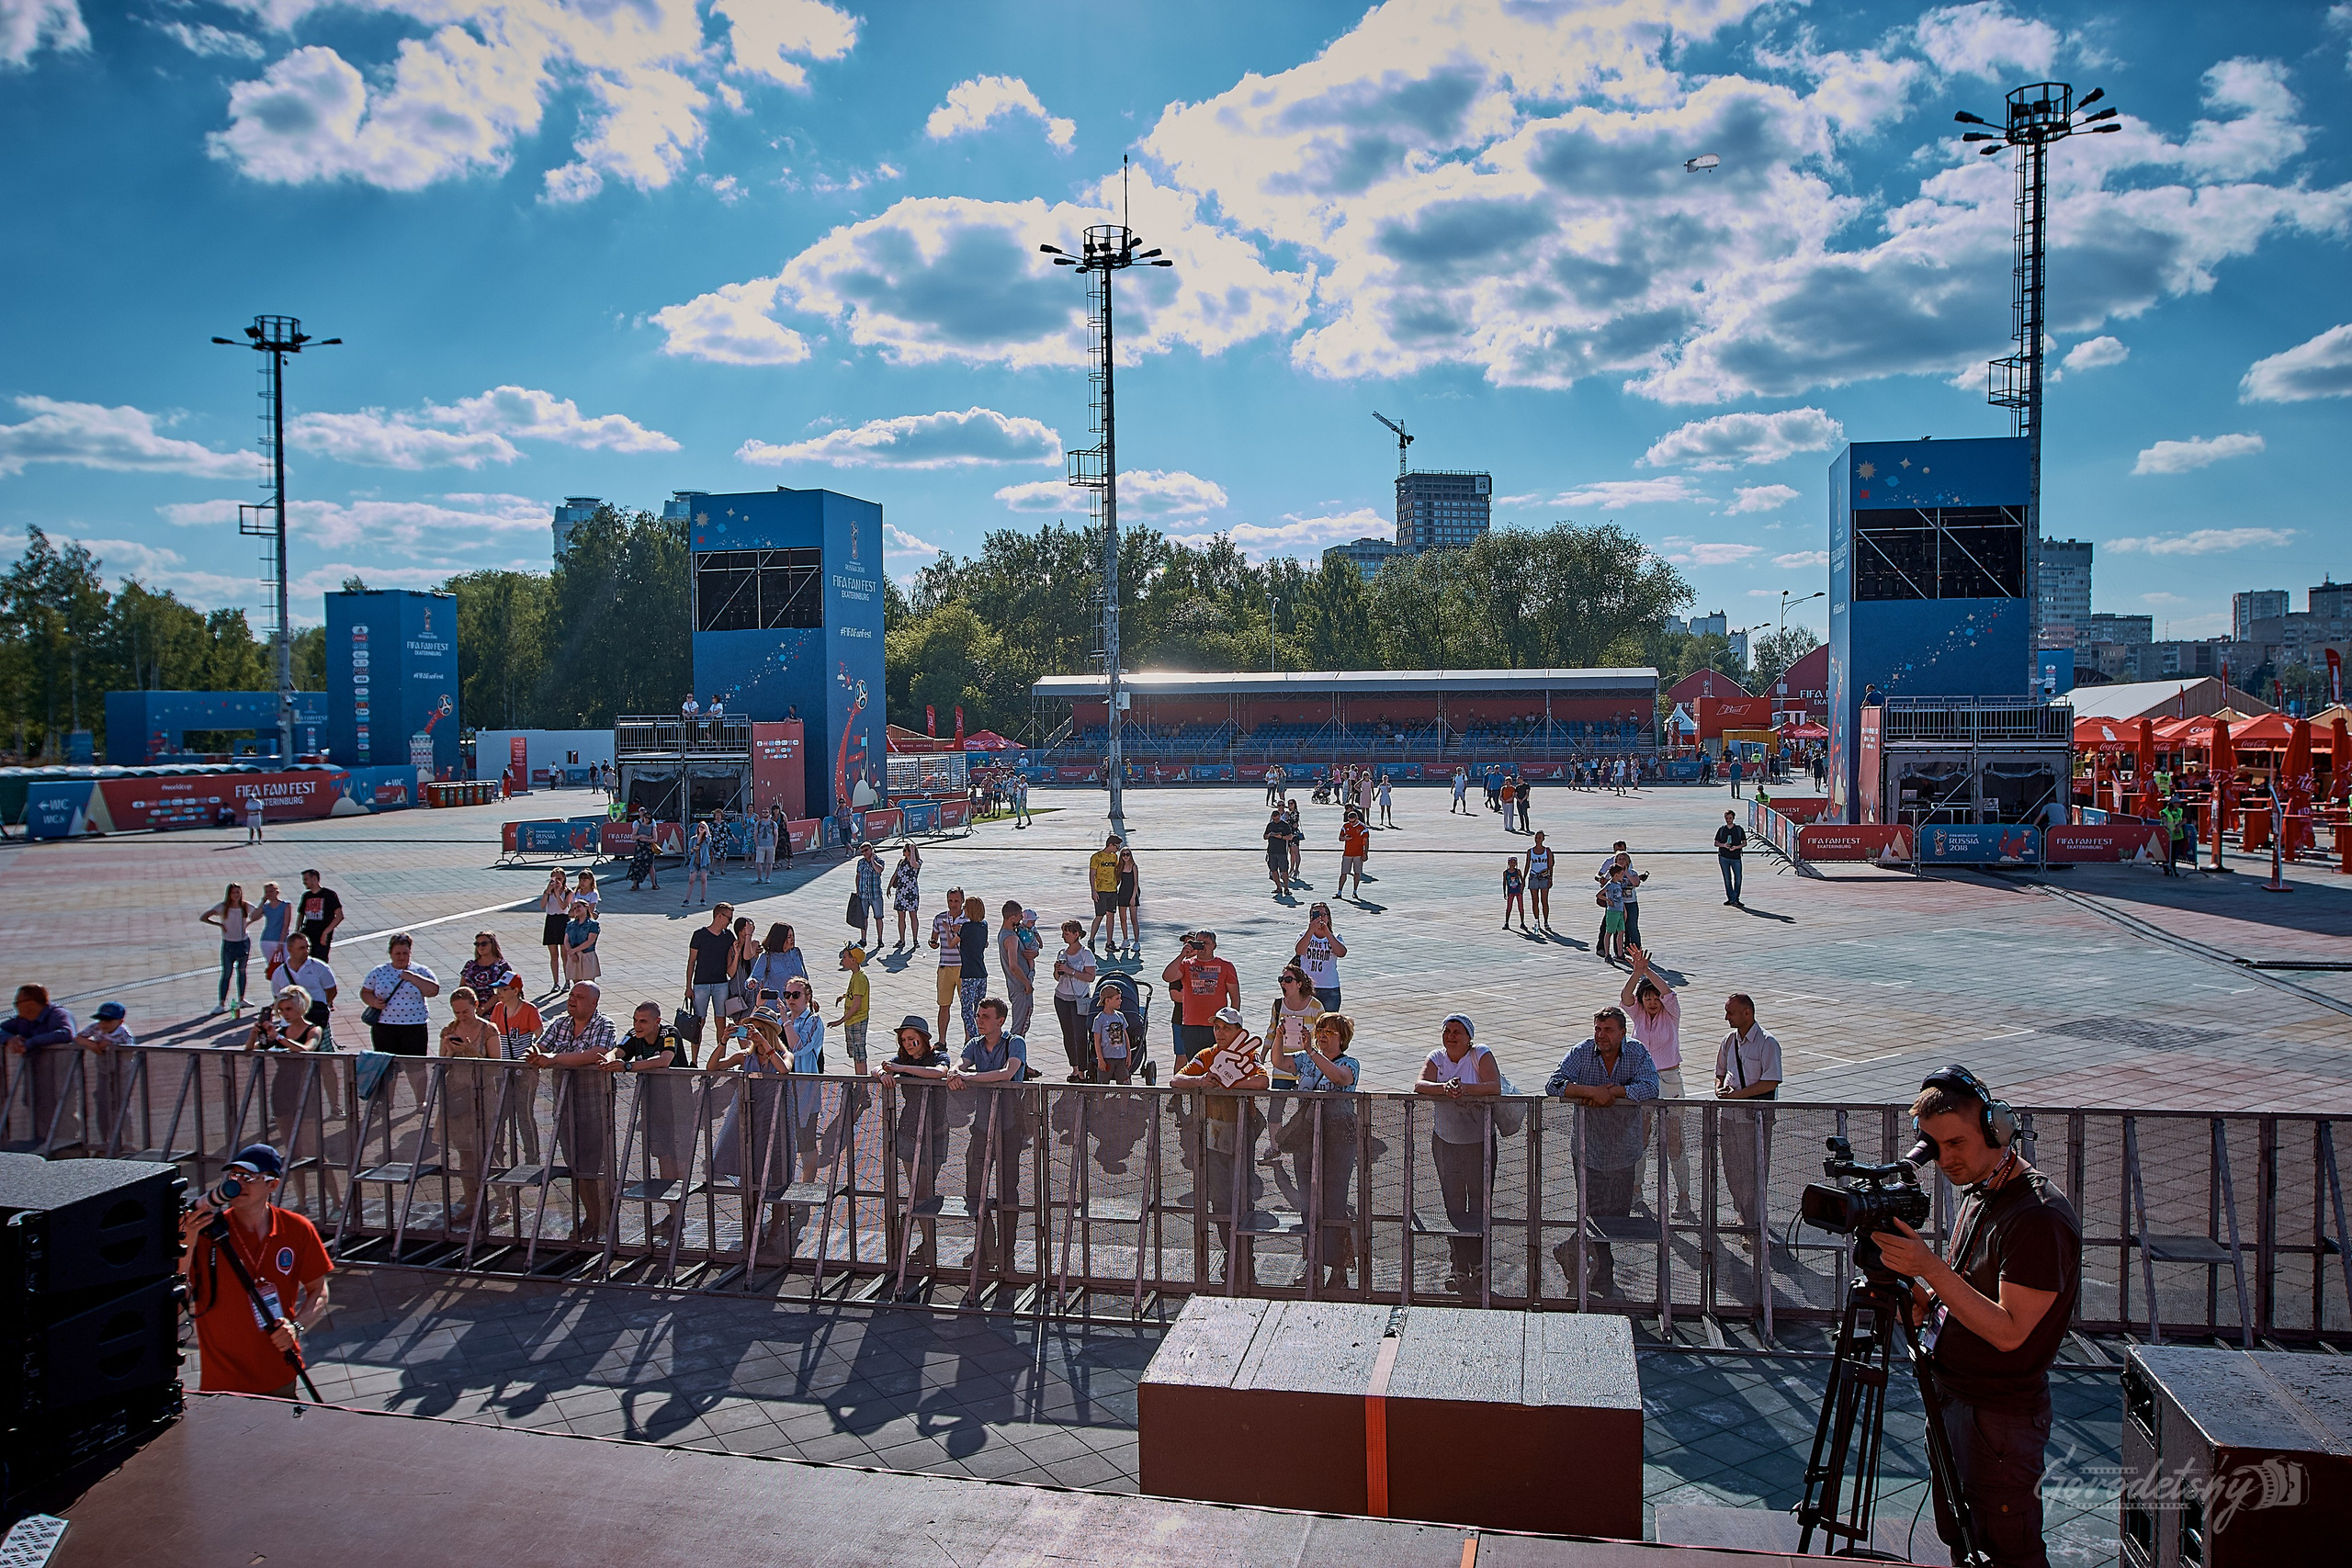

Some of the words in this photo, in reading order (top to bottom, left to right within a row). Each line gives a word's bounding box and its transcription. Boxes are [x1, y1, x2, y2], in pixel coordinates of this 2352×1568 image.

[833, 575, 847, 588] FIFA
[848, 577, 861, 591] FAN
[862, 580, 876, 592] FEST
[841, 590, 870, 601] EKATERINBURG
[840, 627, 872, 638] #FIFAFanFest
[406, 641, 420, 649] FIFA
[1800, 690, 1823, 698] FIFA
[1724, 705, 1742, 714] Bud
[235, 784, 261, 798] FIFA
[264, 783, 287, 797] FAN
[288, 781, 316, 795] FEST
[50, 799, 69, 810] WC
[43, 815, 57, 824] WC
[1310, 940, 1322, 949] ARE
[1307, 948, 1331, 961] DREAM
[1311, 961, 1322, 972] BIG
